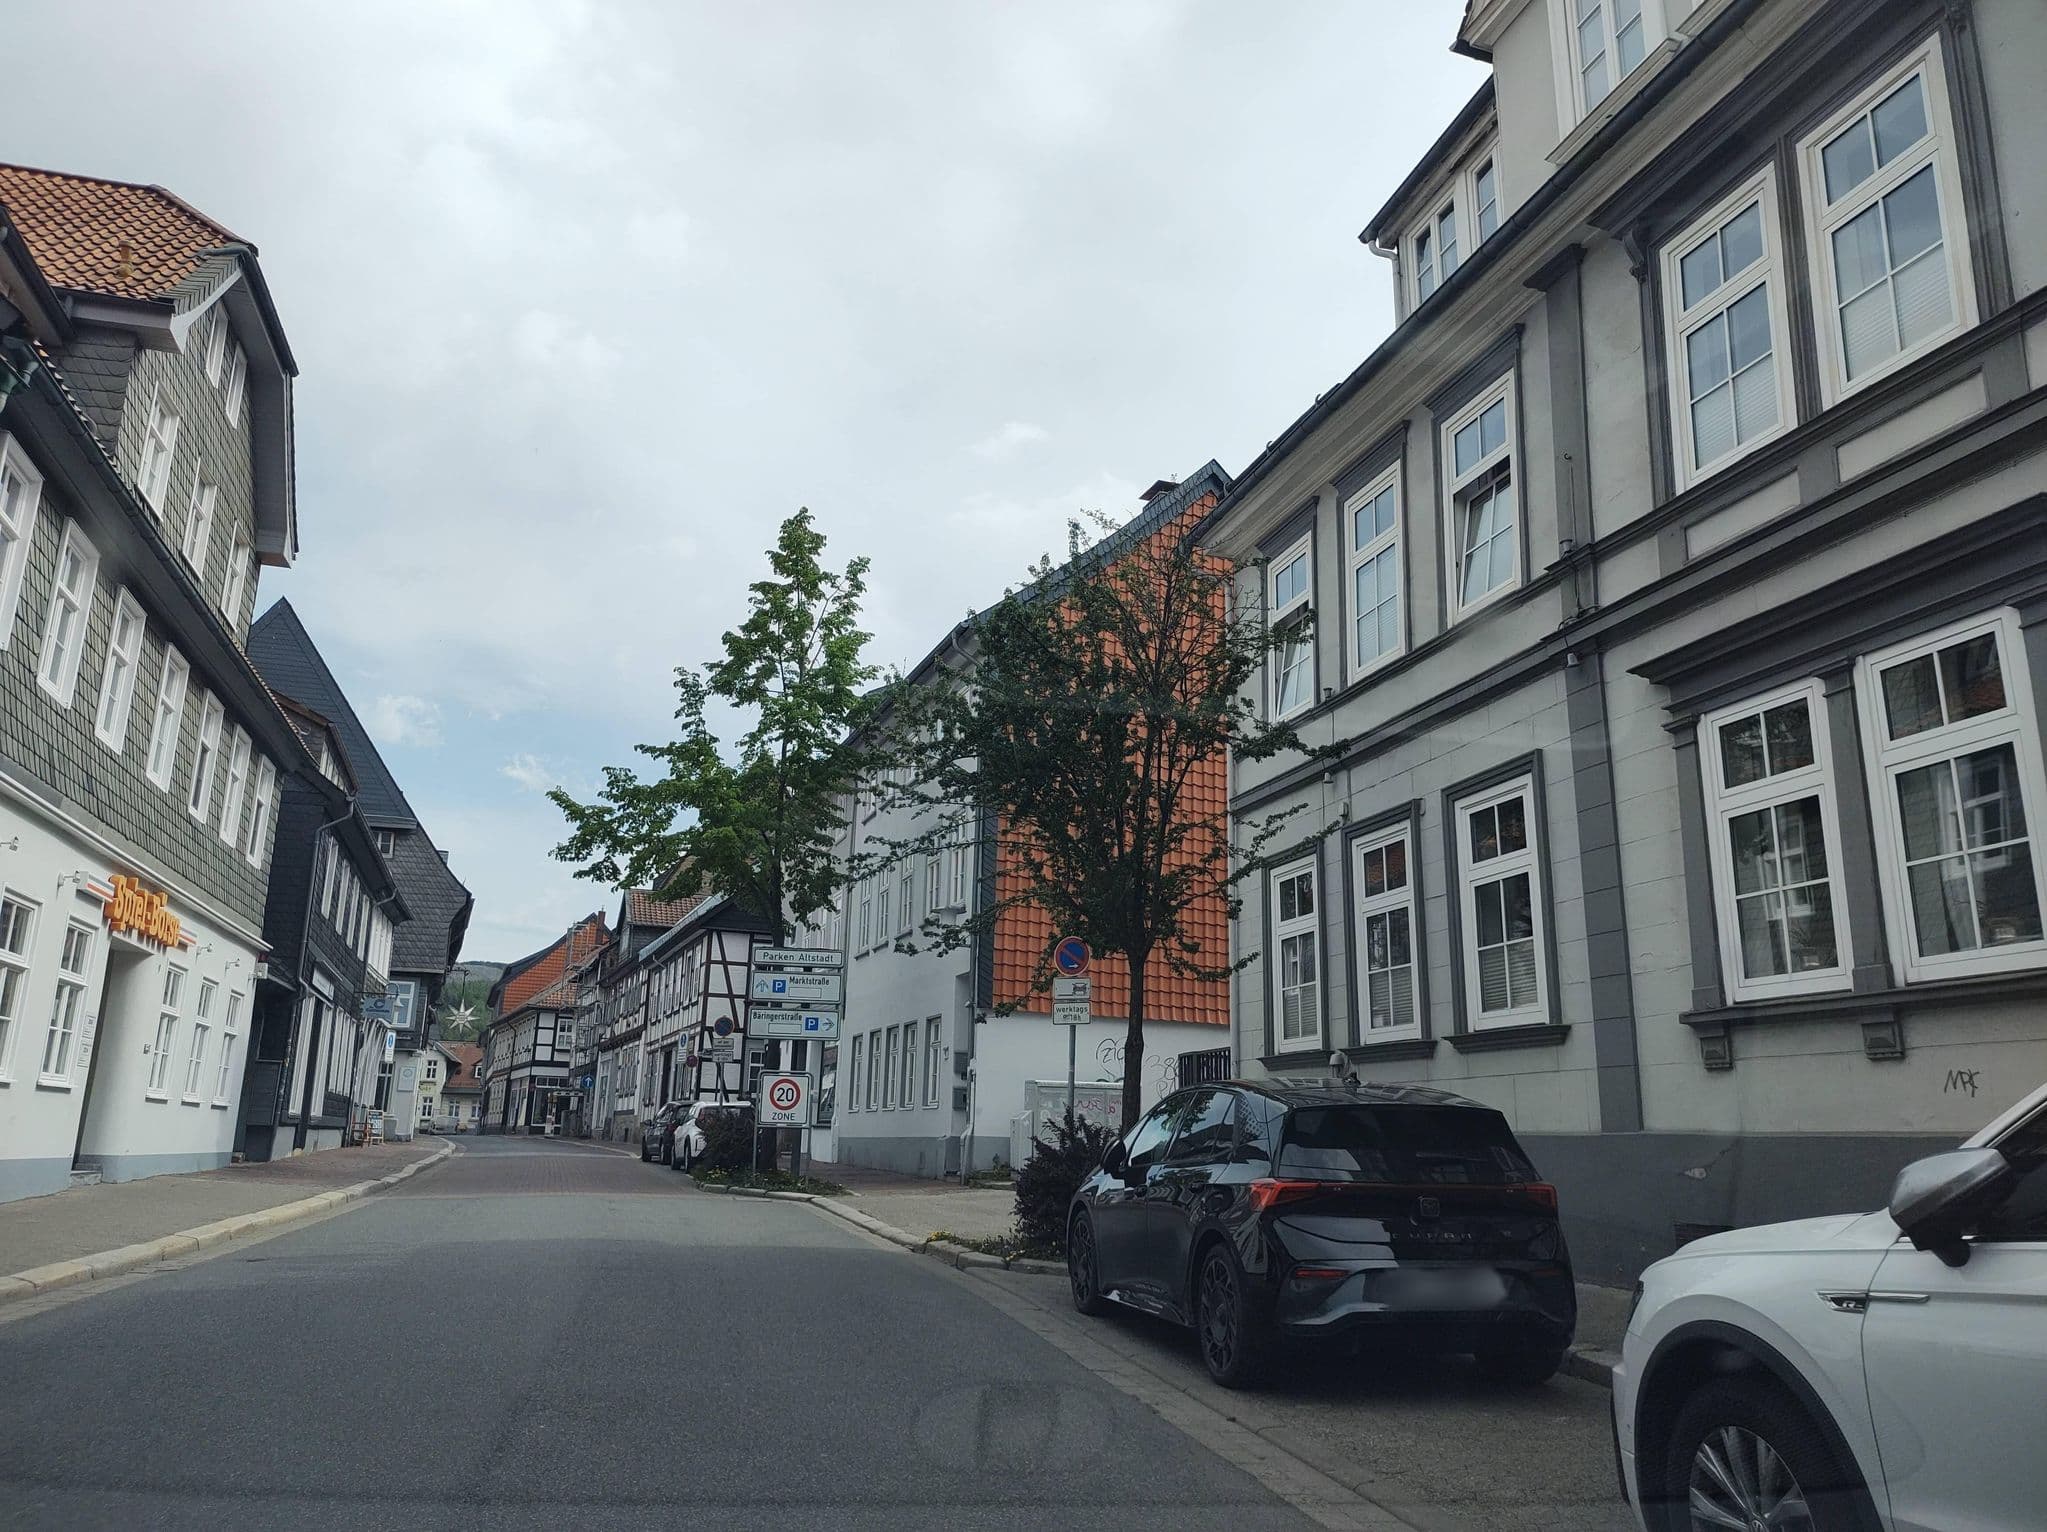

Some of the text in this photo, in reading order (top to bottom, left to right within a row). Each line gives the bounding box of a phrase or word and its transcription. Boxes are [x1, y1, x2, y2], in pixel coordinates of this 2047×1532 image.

[763, 952, 833, 963] Parken Altstadt
[789, 976, 830, 986] Marktstraße
[1056, 1006, 1088, 1014] werktags
[752, 1012, 803, 1022] Bäringerstraße
[776, 1087, 794, 1102] 20
[771, 1112, 796, 1120] ZONE
